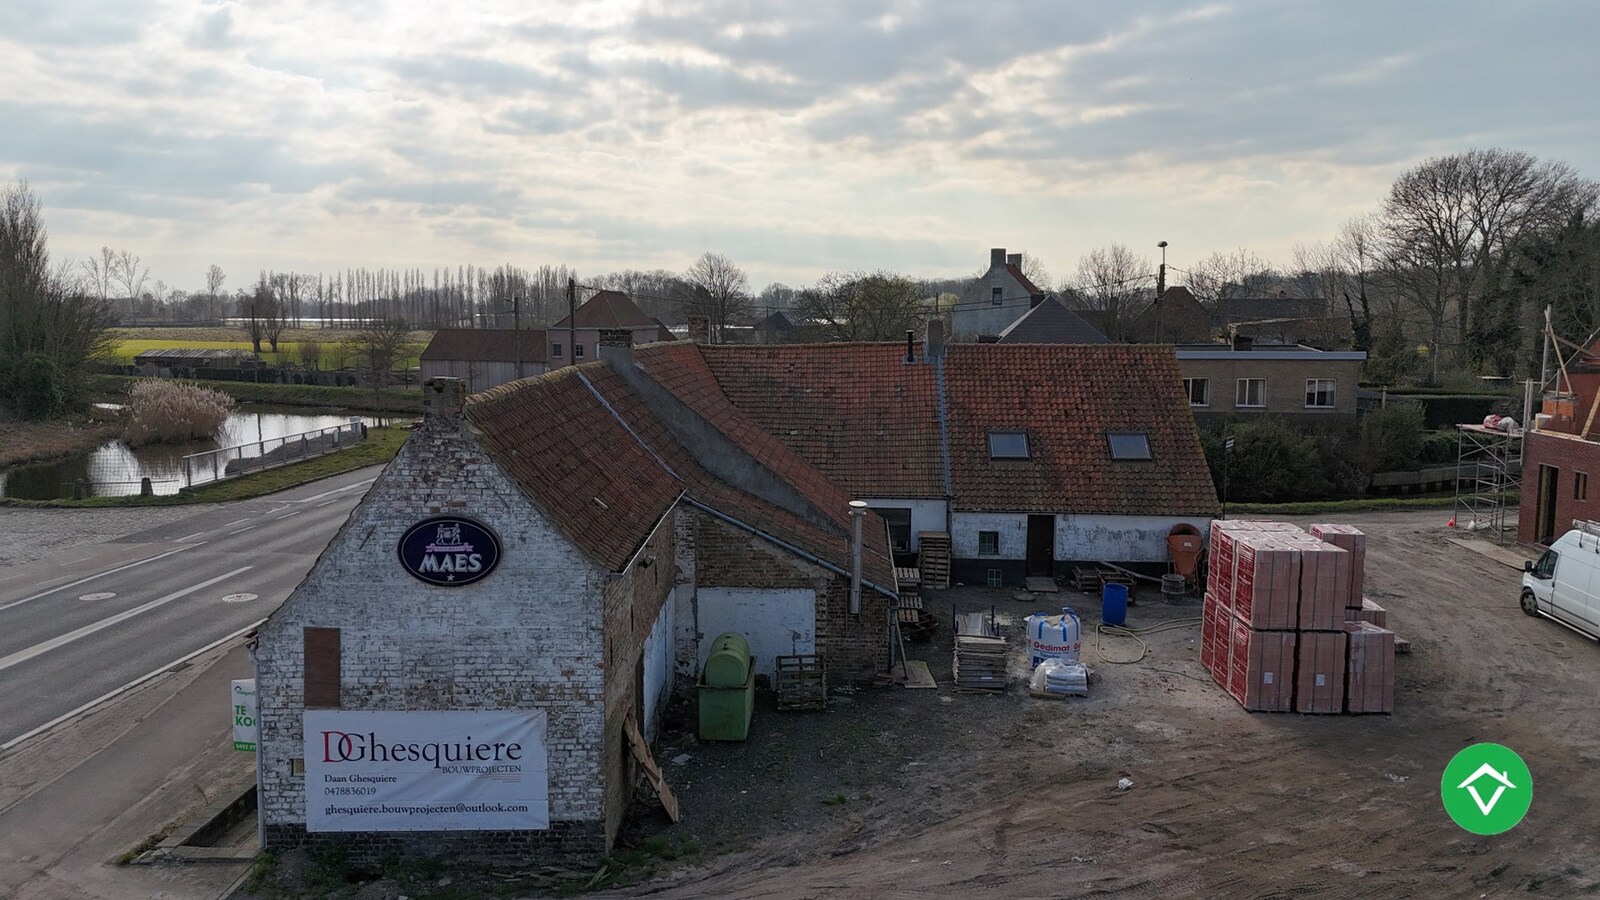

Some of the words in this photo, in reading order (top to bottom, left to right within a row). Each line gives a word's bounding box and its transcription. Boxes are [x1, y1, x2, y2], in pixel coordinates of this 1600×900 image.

[419, 553, 482, 573] MAES
[1034, 641, 1069, 651] Gedimat
[234, 705, 247, 716] TE
[235, 716, 255, 727] KO
[442, 764, 522, 774] BOUWPROJECTEN
[324, 774, 347, 783] Daan
[349, 774, 397, 784] Ghesquiere
[324, 786, 377, 796] 0478836019
[325, 803, 528, 815] ghesquiere.bouwprojecten@outlook.com
